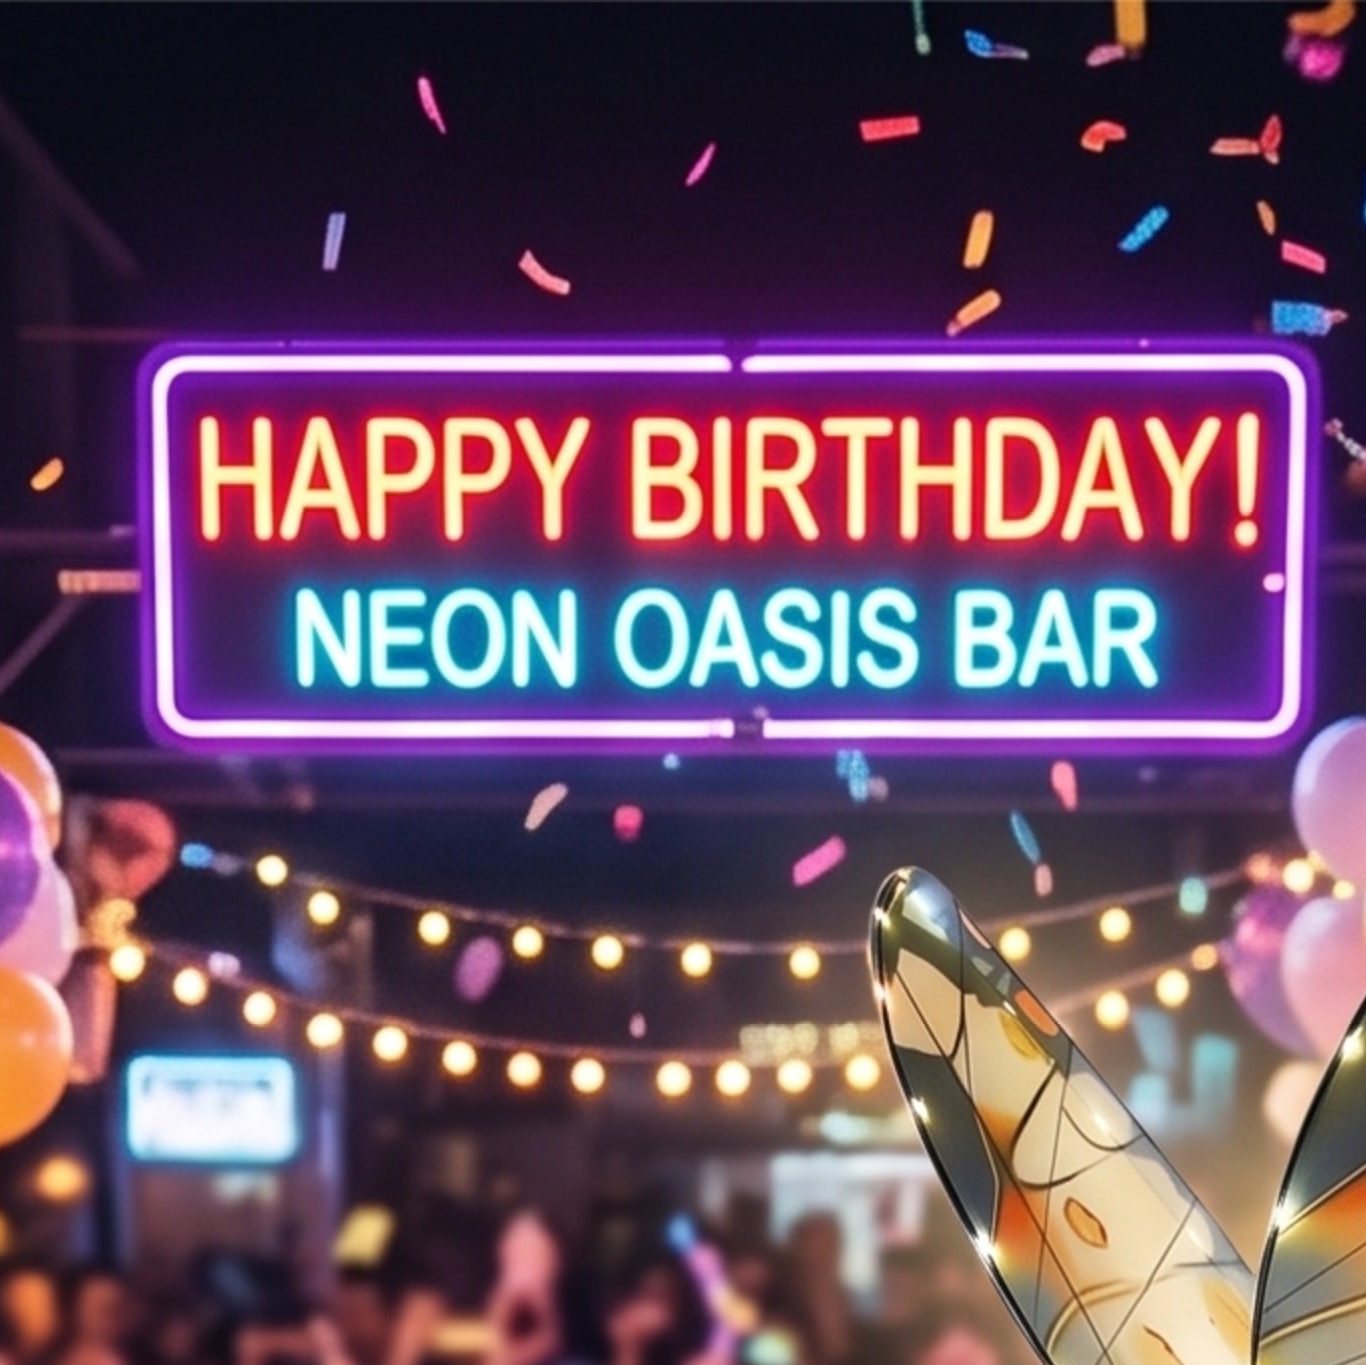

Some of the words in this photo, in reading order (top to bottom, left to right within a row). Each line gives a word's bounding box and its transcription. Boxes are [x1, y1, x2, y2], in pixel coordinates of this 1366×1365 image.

[197, 415, 591, 542] HAPPY
[630, 411, 1262, 549] BIRTHDAY!
[294, 588, 577, 688] NEON
[613, 588, 921, 690] OASIS
[952, 588, 1160, 689] BAR
